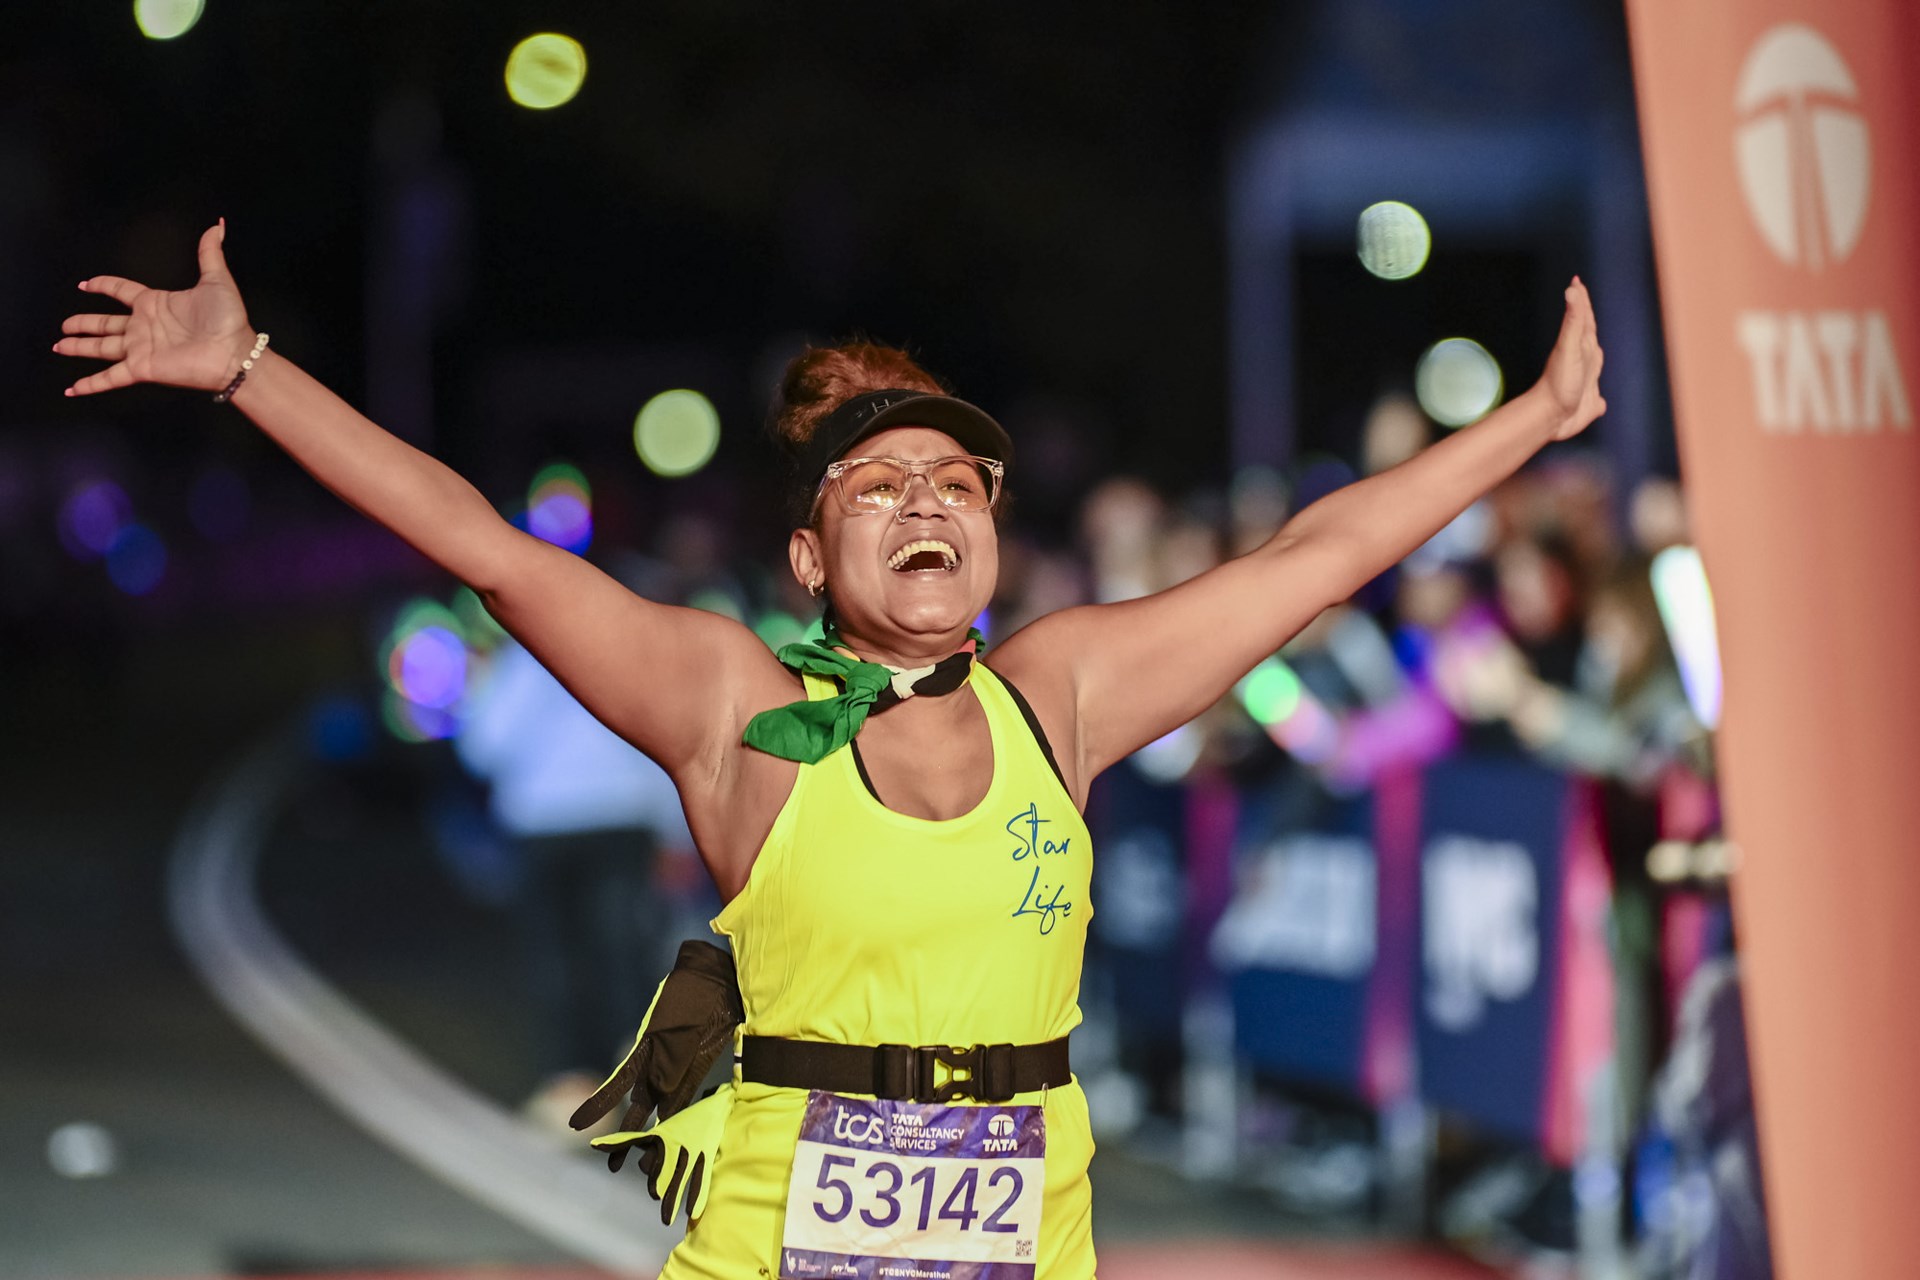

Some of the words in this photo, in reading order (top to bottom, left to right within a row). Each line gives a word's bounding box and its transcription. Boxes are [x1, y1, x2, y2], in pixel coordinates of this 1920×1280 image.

[1737, 310, 1910, 433] TATA
[1006, 802, 1070, 861] Star
[1012, 865, 1072, 935] Life
[834, 1104, 885, 1145] tcs
[890, 1125, 965, 1140] CONSULTANCY
[892, 1113, 923, 1126] TATA
[889, 1137, 937, 1151] SERVICES
[982, 1139, 1018, 1152] TATA
[812, 1153, 1024, 1234] 53142
